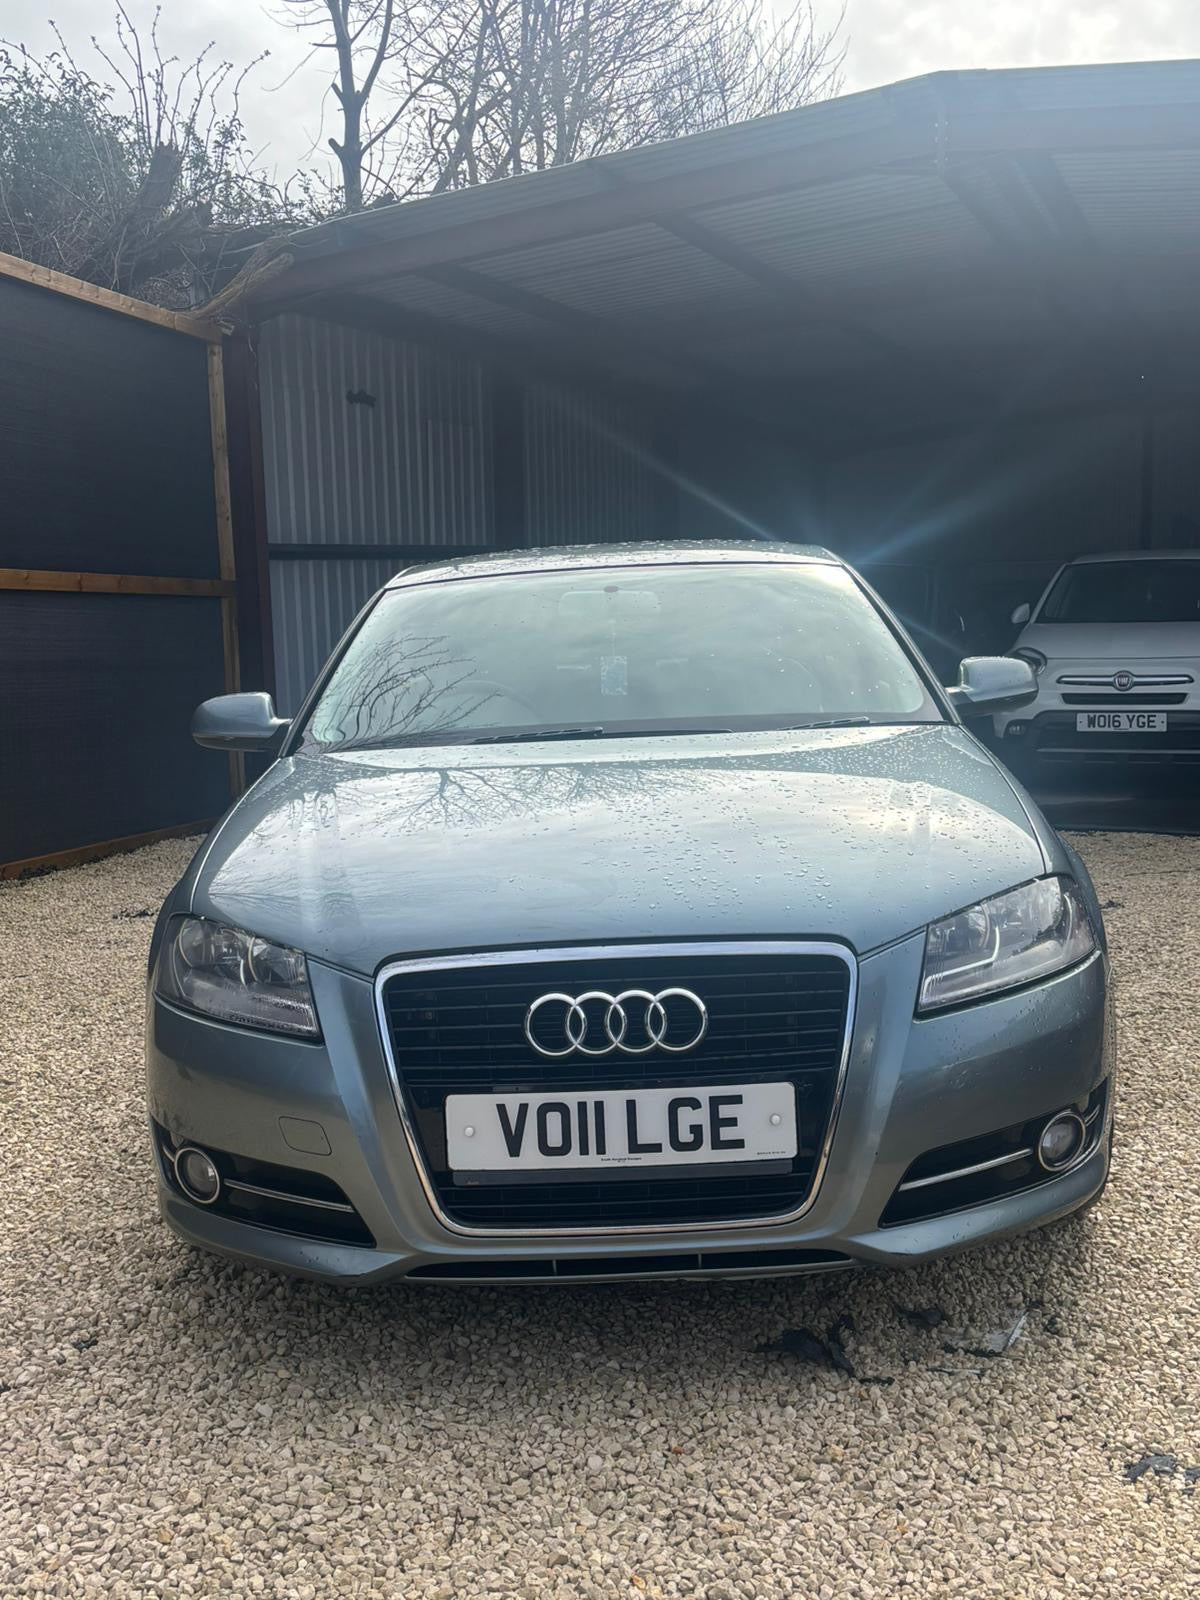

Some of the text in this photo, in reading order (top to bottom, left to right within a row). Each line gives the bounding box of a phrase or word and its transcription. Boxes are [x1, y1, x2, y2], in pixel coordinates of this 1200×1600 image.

[1087, 714, 1157, 729] WO16 YGE
[496, 1094, 746, 1157] VO11 LGE
